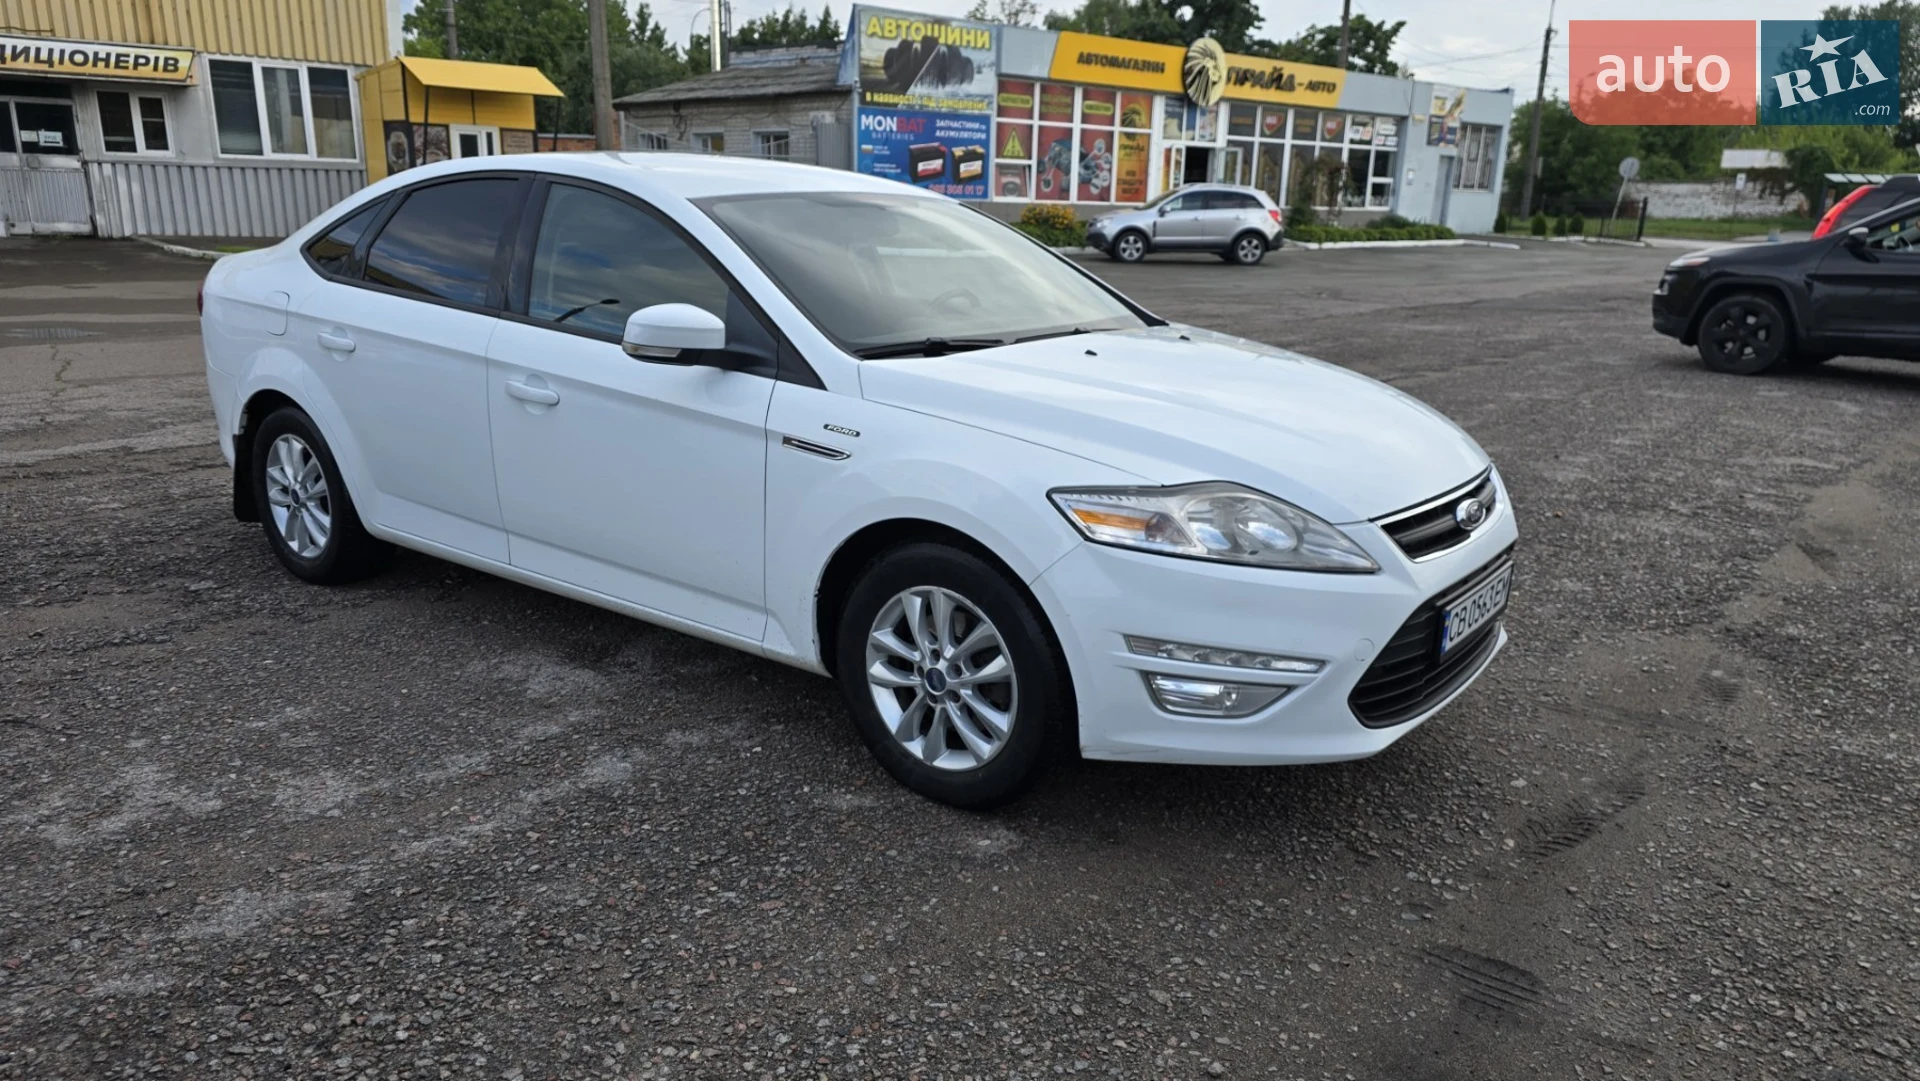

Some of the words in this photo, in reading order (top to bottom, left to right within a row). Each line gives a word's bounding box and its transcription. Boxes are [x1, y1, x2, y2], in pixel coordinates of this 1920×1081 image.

[866, 16, 991, 49] АВТОШИНИ
[1076, 51, 1165, 74] АВТОМАГАЗИН
[860, 114, 926, 133] MONBAT
[871, 132, 915, 141] BATTERIES
[827, 424, 857, 437] FORD
